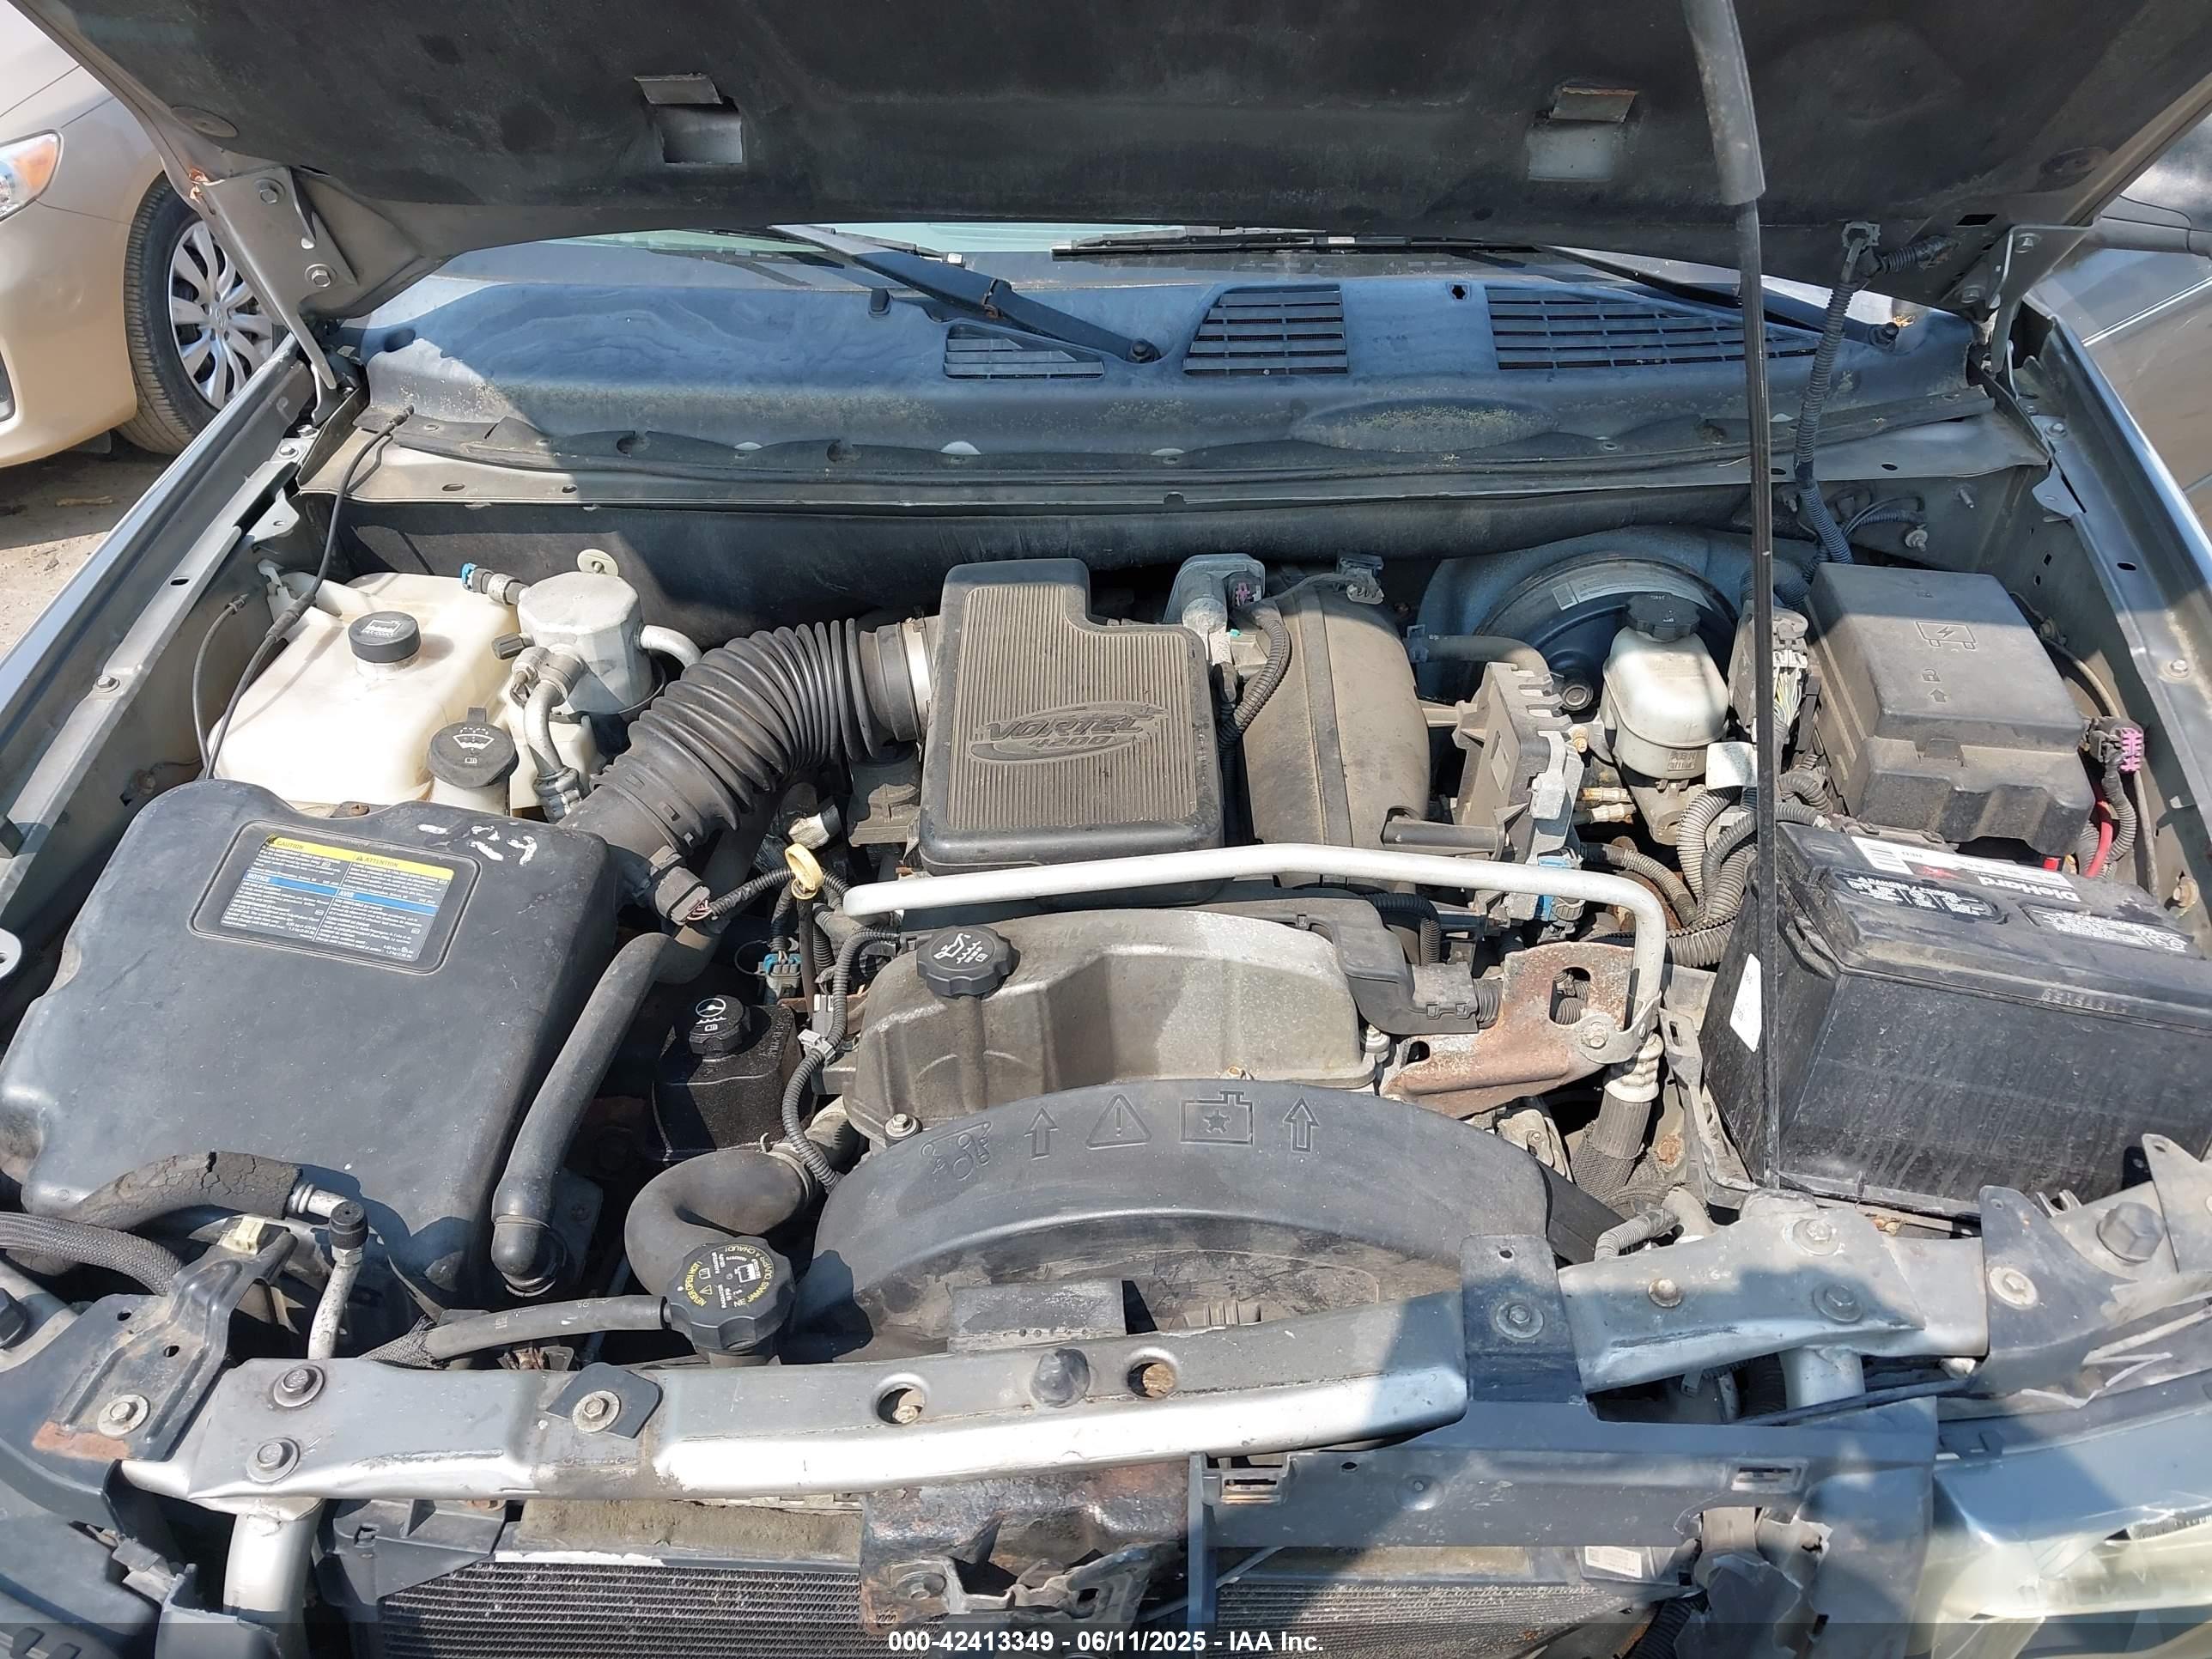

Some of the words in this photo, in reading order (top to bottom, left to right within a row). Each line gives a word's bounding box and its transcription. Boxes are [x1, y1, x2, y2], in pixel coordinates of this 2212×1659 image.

[276, 840, 305, 850] CAUTION
[363, 857, 399, 868] ATTENTION
[1978, 875, 2082, 902] DieHard
